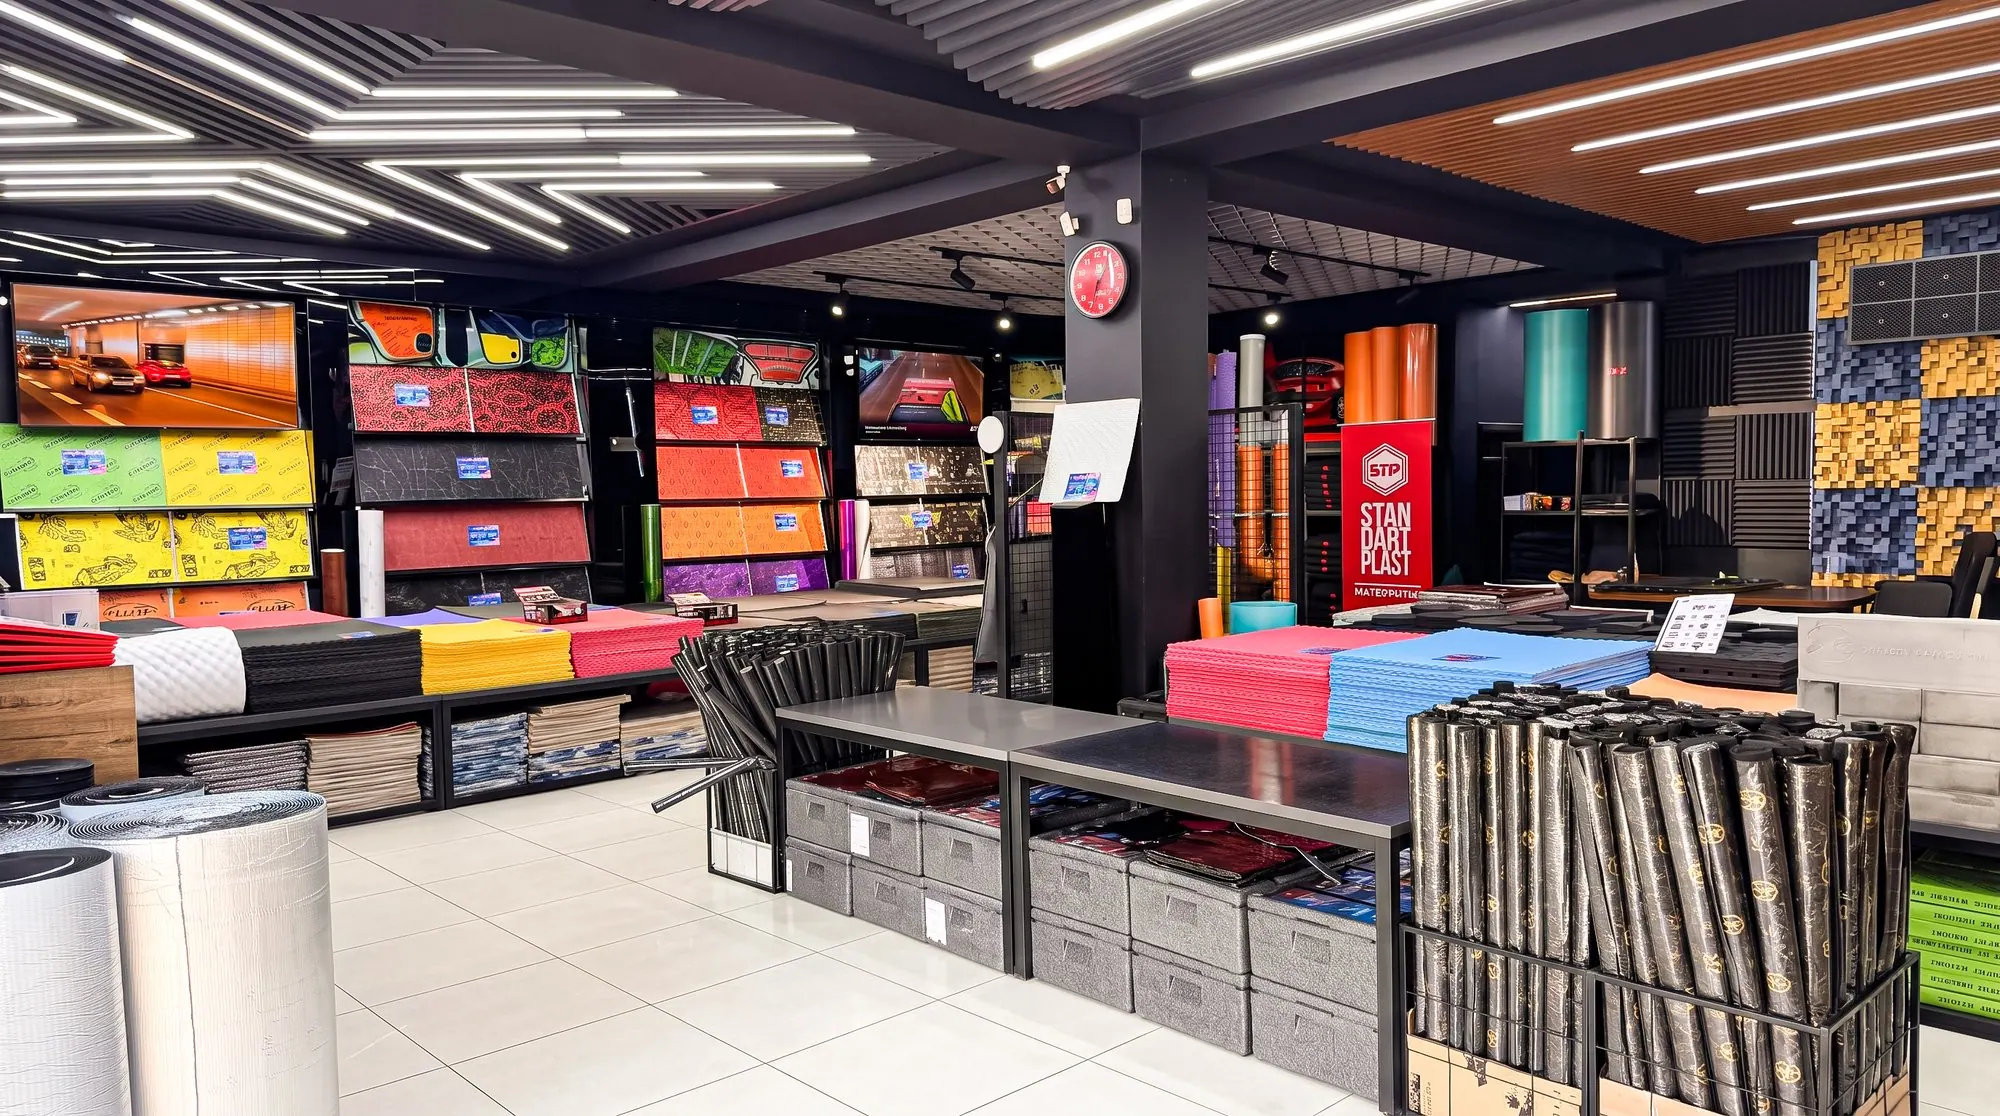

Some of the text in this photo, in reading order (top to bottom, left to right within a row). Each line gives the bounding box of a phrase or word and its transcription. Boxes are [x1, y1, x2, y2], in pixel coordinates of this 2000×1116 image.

[1370, 463, 1401, 477] STP
[1360, 502, 1411, 527] STAN
[1360, 526, 1411, 551] DART
[1360, 550, 1412, 576] PLAST
